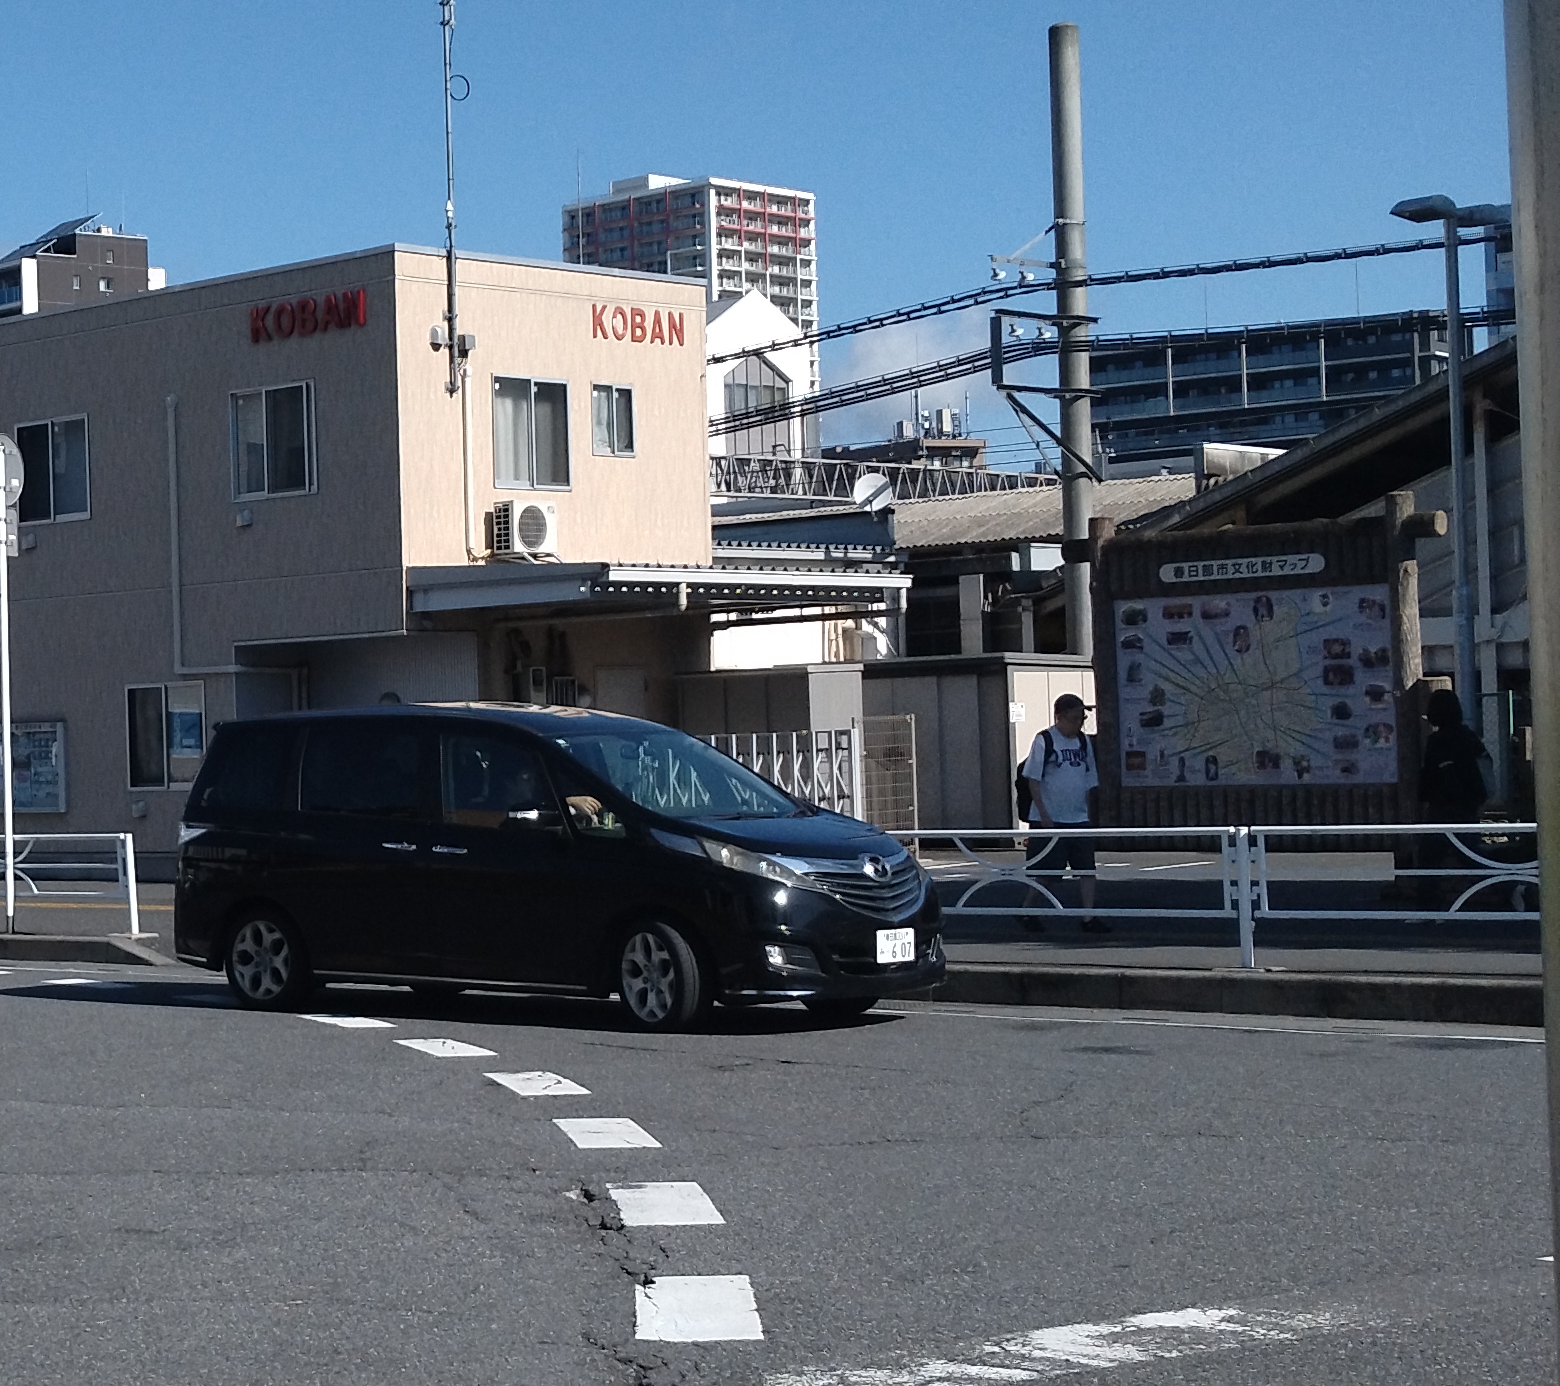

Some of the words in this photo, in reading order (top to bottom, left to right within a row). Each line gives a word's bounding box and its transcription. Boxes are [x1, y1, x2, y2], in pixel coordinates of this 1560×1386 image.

[250, 288, 366, 343] KOBAN
[592, 303, 684, 347] KOBAN
[1173, 556, 1310, 579] 春日部市文化財マップ
